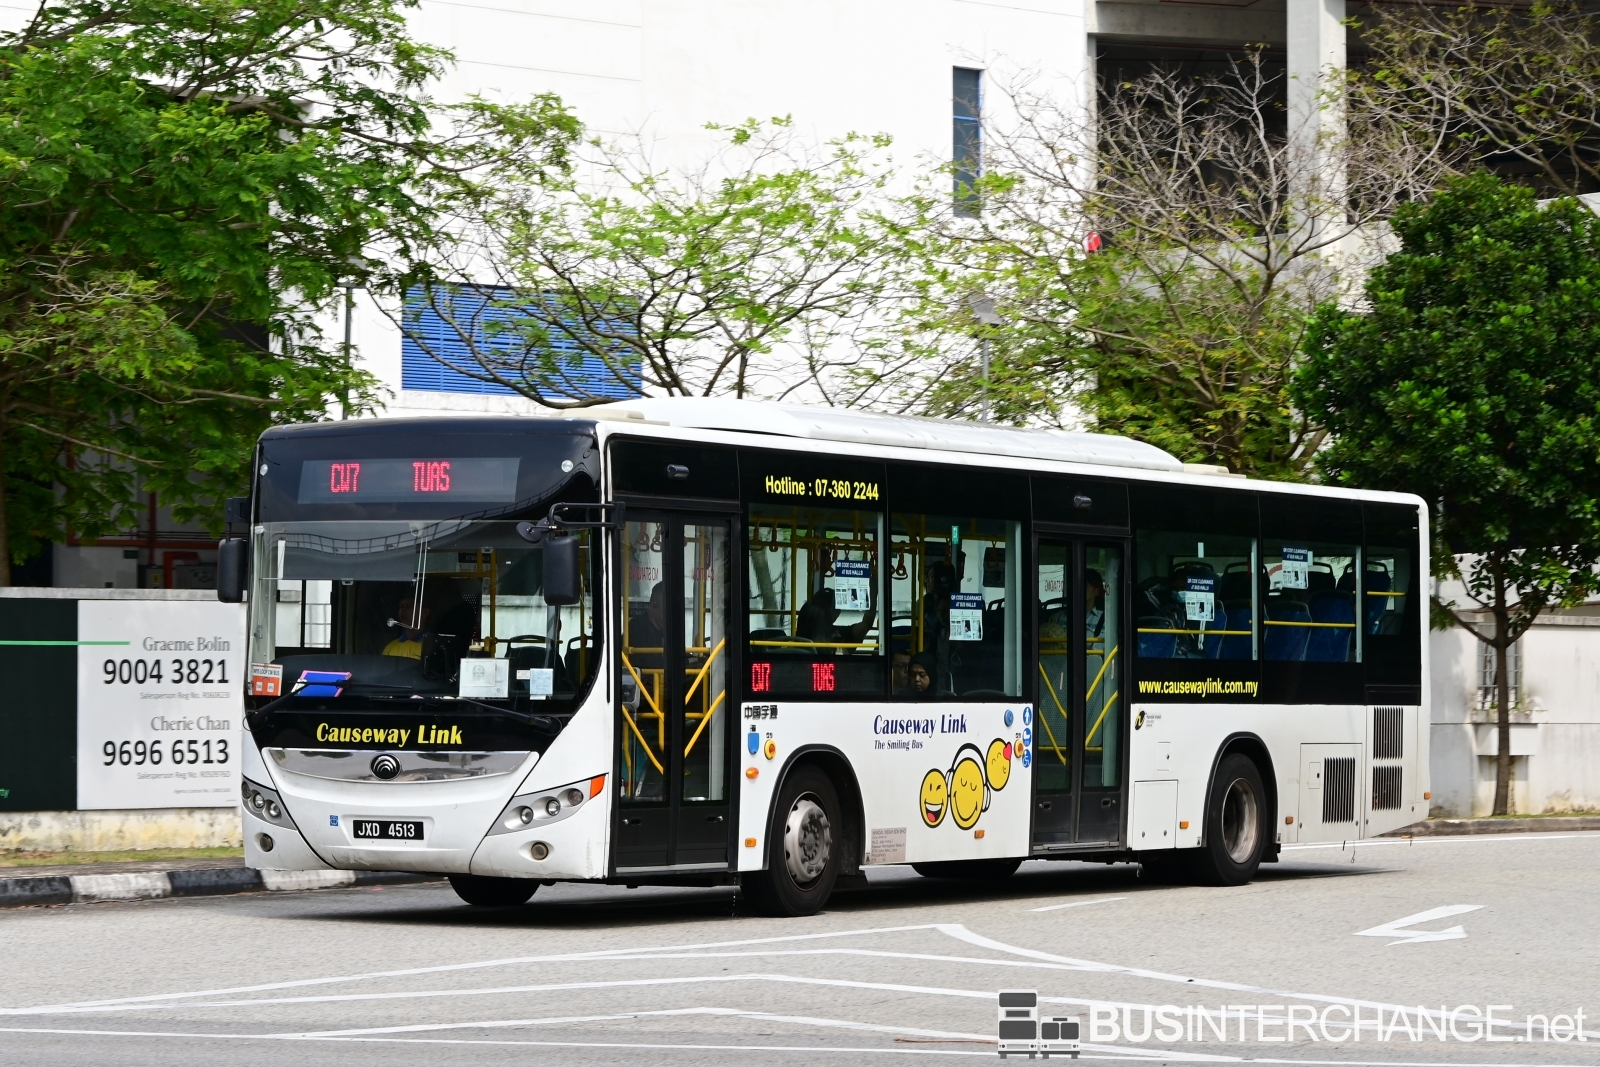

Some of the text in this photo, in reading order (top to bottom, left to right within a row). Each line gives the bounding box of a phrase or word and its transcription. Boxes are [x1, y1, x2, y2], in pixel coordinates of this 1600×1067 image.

[330, 462, 450, 493] CW7 TUAS
[766, 475, 806, 495] Hotline
[815, 478, 851, 498] 07-360
[854, 482, 879, 500] 2244
[142, 636, 230, 652] Graeme Bolin
[103, 658, 229, 684] 9004 3821
[812, 663, 835, 692] TUAS
[1138, 678, 1258, 697] www.causewaylink.com.my
[150, 716, 230, 731] Cherie Chan
[316, 723, 462, 748] Causeway Link
[874, 714, 967, 738] Causeway Link
[103, 740, 229, 766] 9696 6513
[874, 739, 923, 751] The Smiling Bus
[358, 822, 415, 838] JXD 4513
